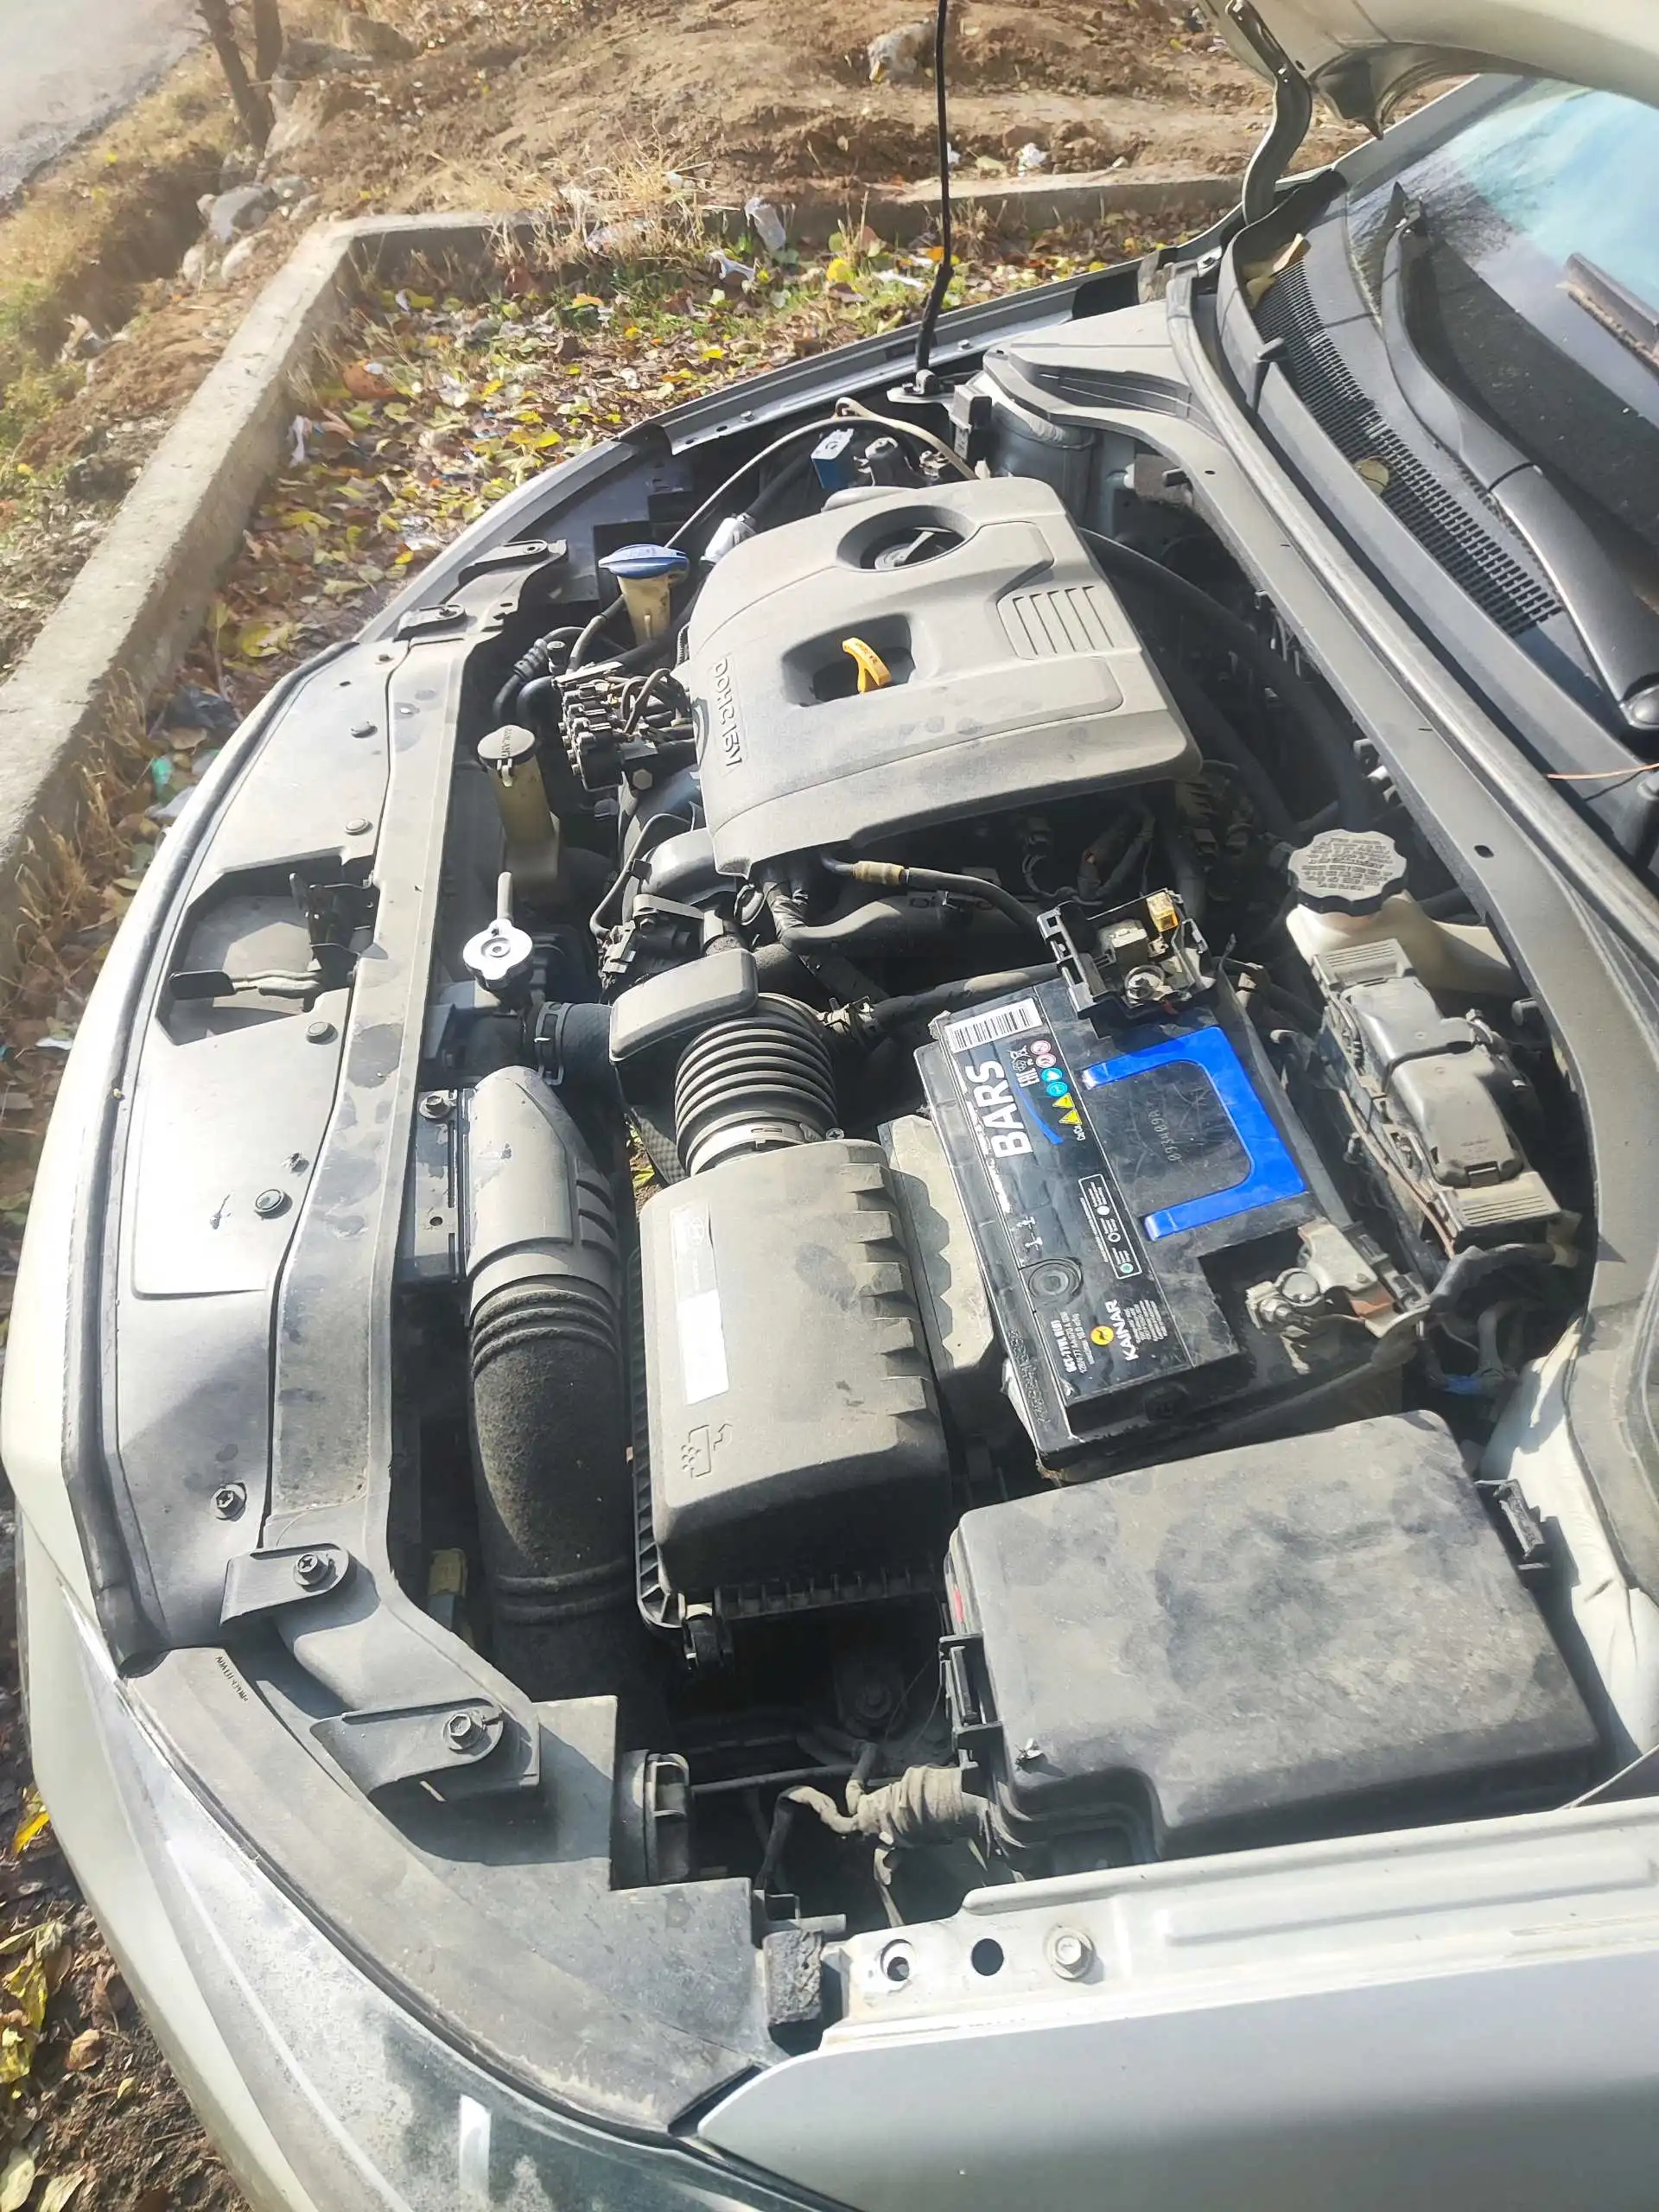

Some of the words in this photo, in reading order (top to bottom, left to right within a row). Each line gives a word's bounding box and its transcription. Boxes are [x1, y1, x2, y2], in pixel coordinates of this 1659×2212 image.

[715, 658, 734, 725] DOHC
[965, 1060, 1033, 1158] BARS
[1104, 1299, 1139, 1362] KAINAR
